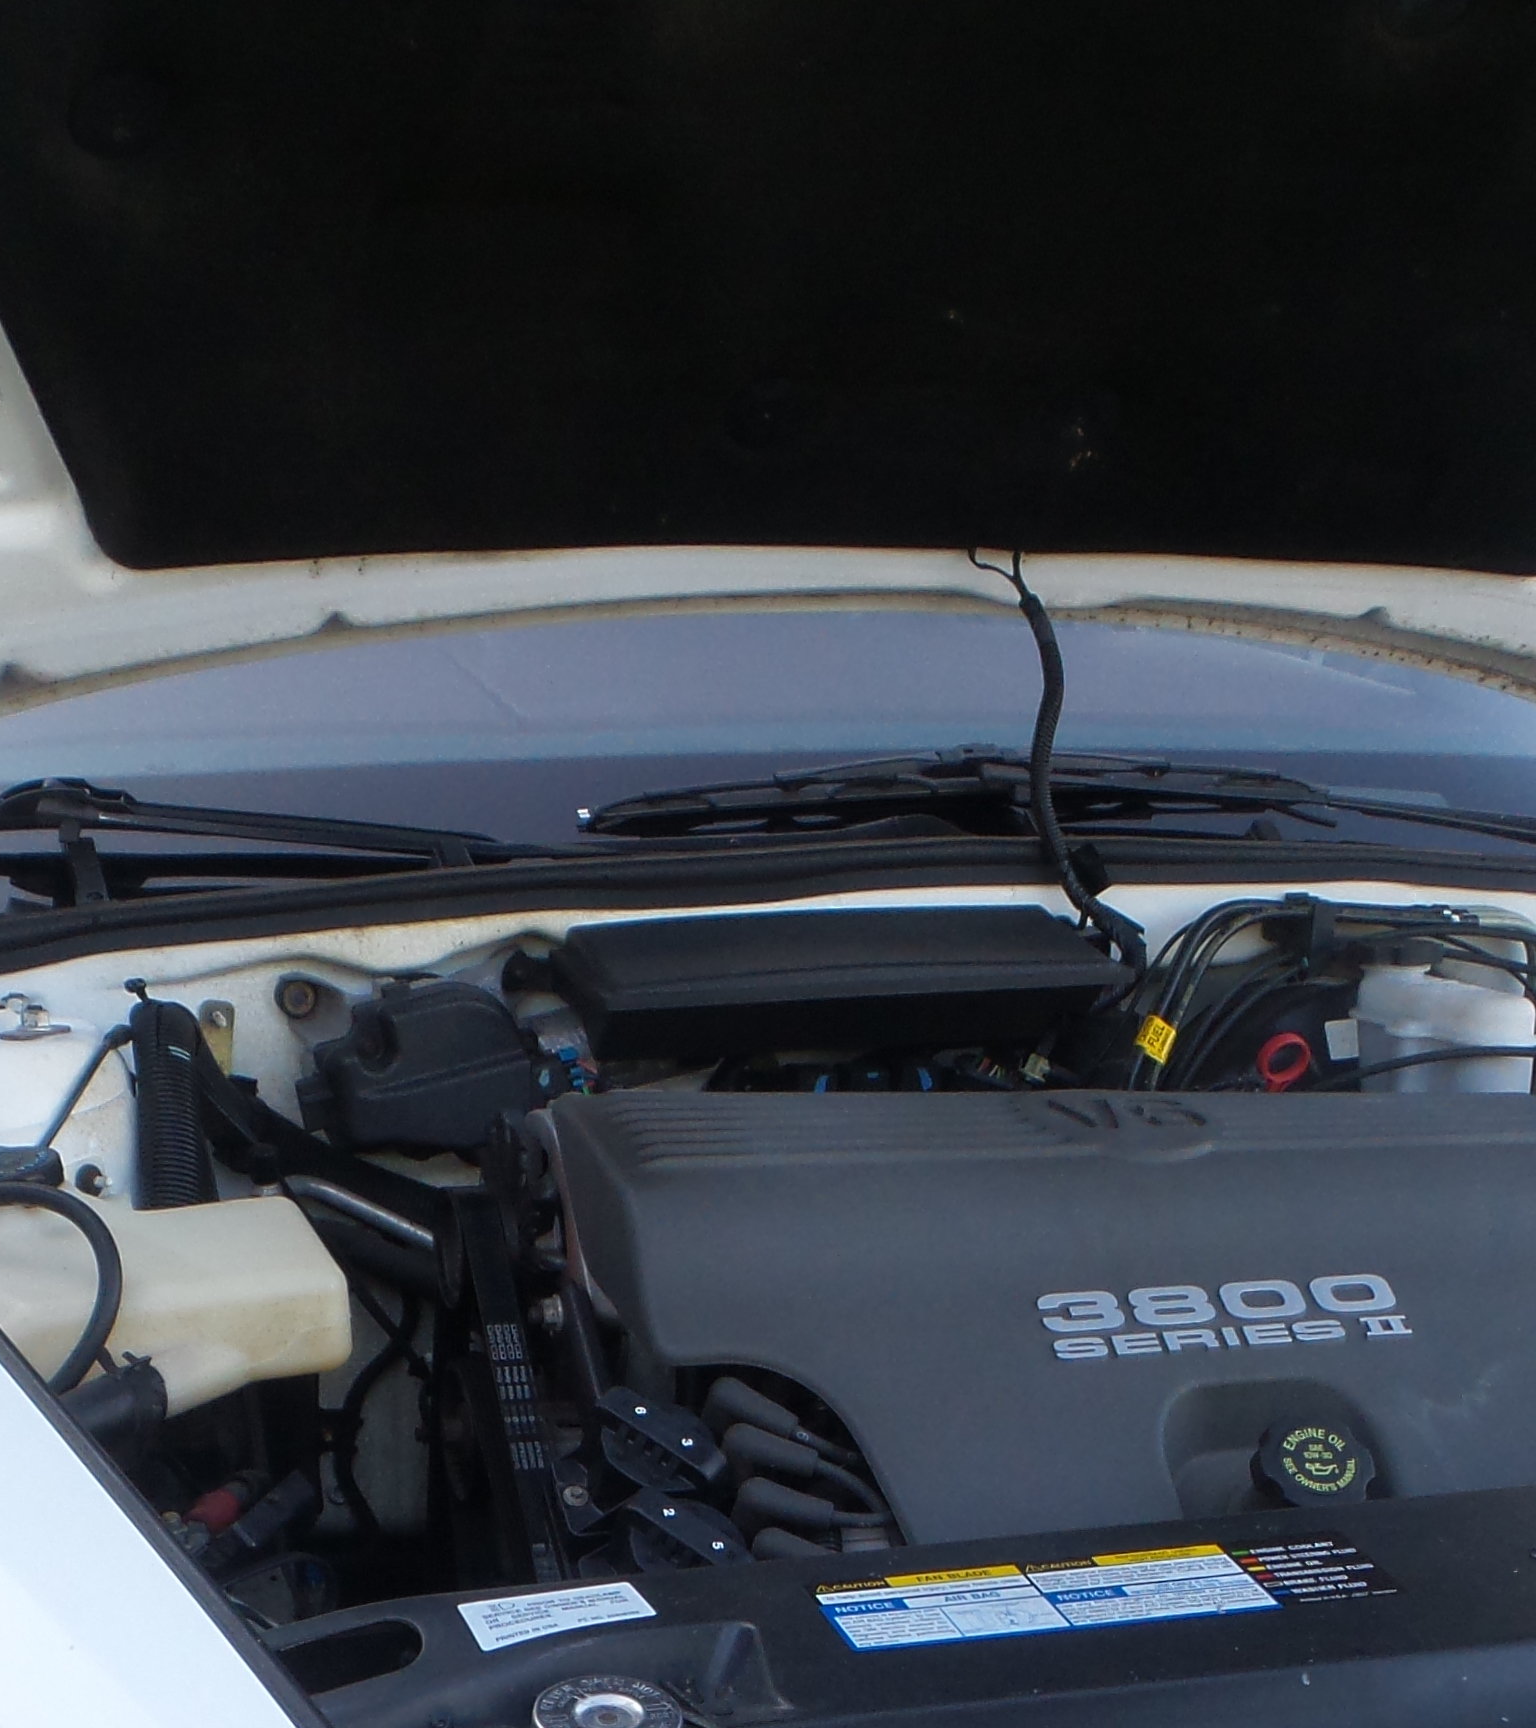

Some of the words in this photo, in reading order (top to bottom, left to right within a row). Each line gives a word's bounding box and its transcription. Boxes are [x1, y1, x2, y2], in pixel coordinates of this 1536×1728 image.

[1147, 1025, 1165, 1048] FUEL
[1036, 1273, 1397, 1333] 3800
[1052, 1319, 1347, 1360] SERIES
[1359, 1315, 1413, 1339] II
[634, 1406, 647, 1415] 6
[681, 1438, 693, 1447] 3
[1283, 1428, 1325, 1451] ENGINE
[1328, 1434, 1346, 1452] OIL
[1283, 1457, 1298, 1475] SEE
[1295, 1473, 1338, 1492] OWNER'S
[1336, 1457, 1356, 1488] MANUAL
[662, 1508, 675, 1517] 2
[712, 1541, 724, 1550] 5
[1039, 1560, 1092, 1570] CAUTION
[916, 1573, 943, 1582] FAN
[947, 1569, 992, 1581] BLADE
[833, 1581, 886, 1591] CAUTION
[945, 1594, 967, 1602] AIR
[971, 1591, 1001, 1600] BAG
[1057, 1589, 1113, 1601] NOTICE
[834, 1602, 895, 1613] NOTICE
[495, 1629, 530, 1642] PRINTED
